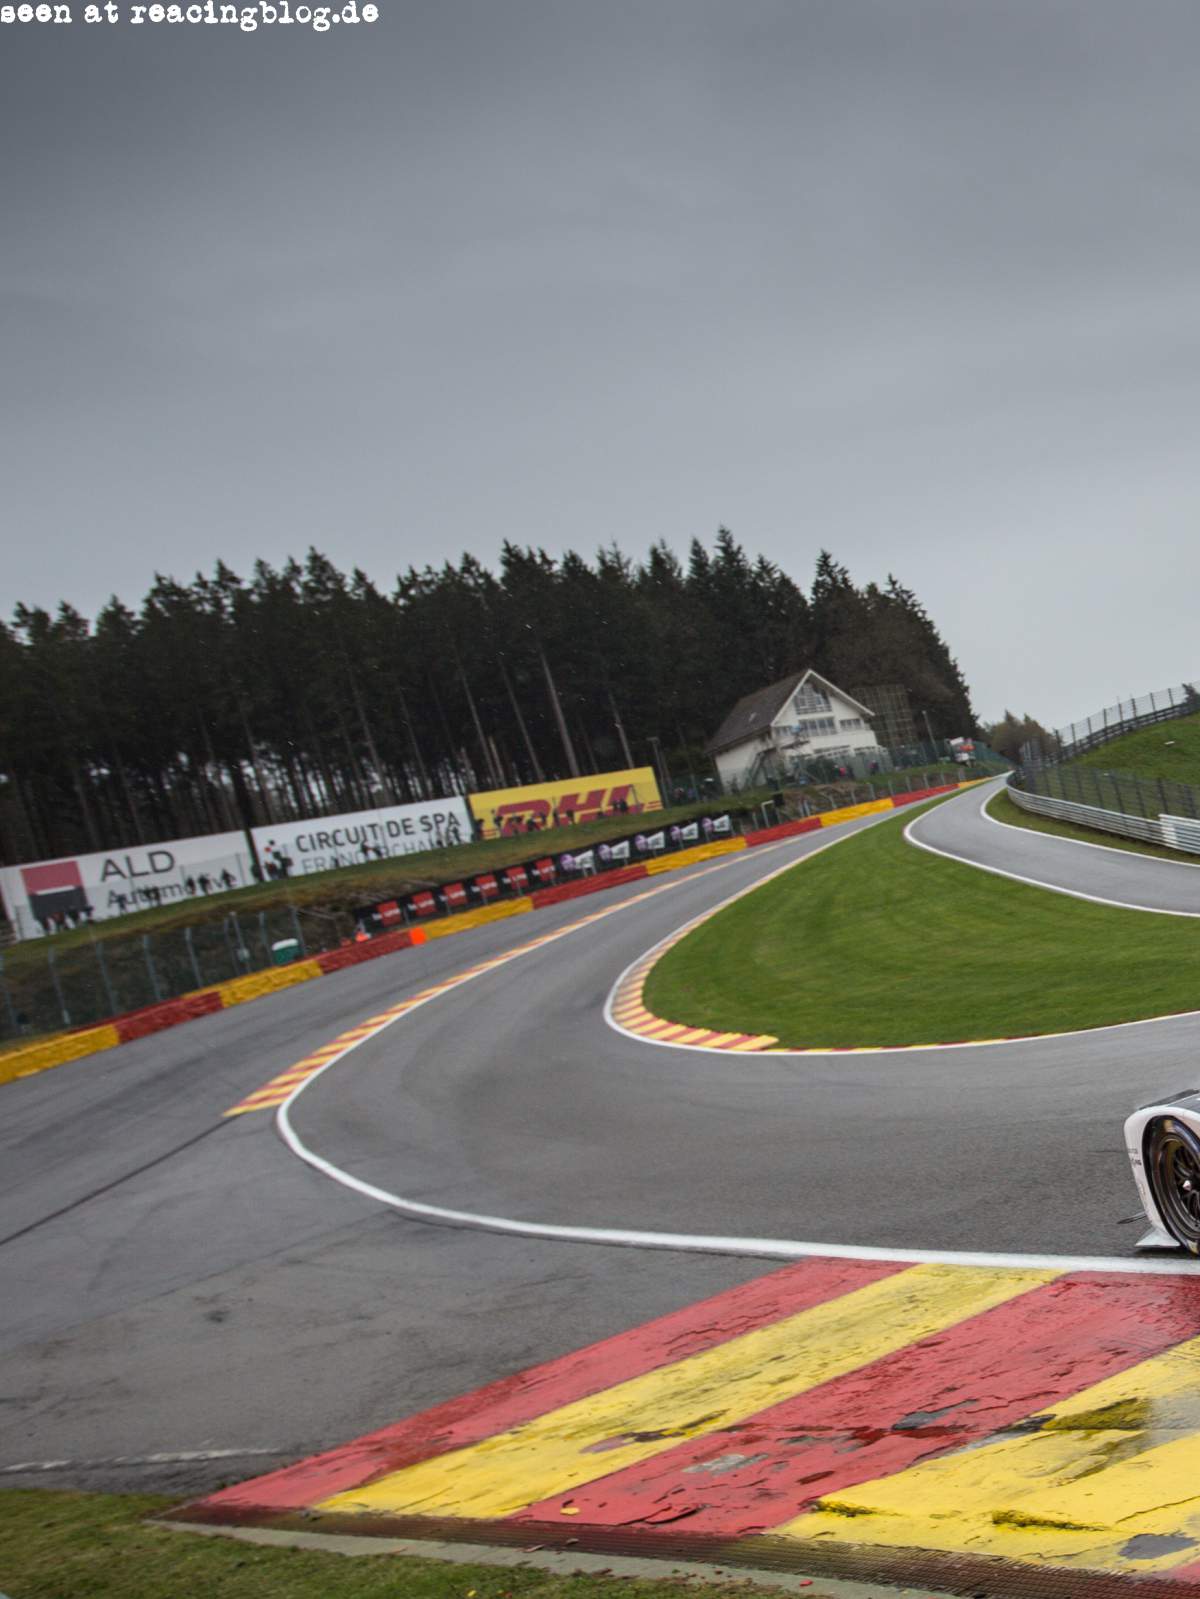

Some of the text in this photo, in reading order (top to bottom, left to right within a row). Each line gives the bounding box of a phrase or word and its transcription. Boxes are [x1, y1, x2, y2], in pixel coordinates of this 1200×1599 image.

[294, 810, 462, 853] CIRCUIT DE SPA
[495, 784, 645, 838] DHL
[101, 849, 175, 883] ALD
